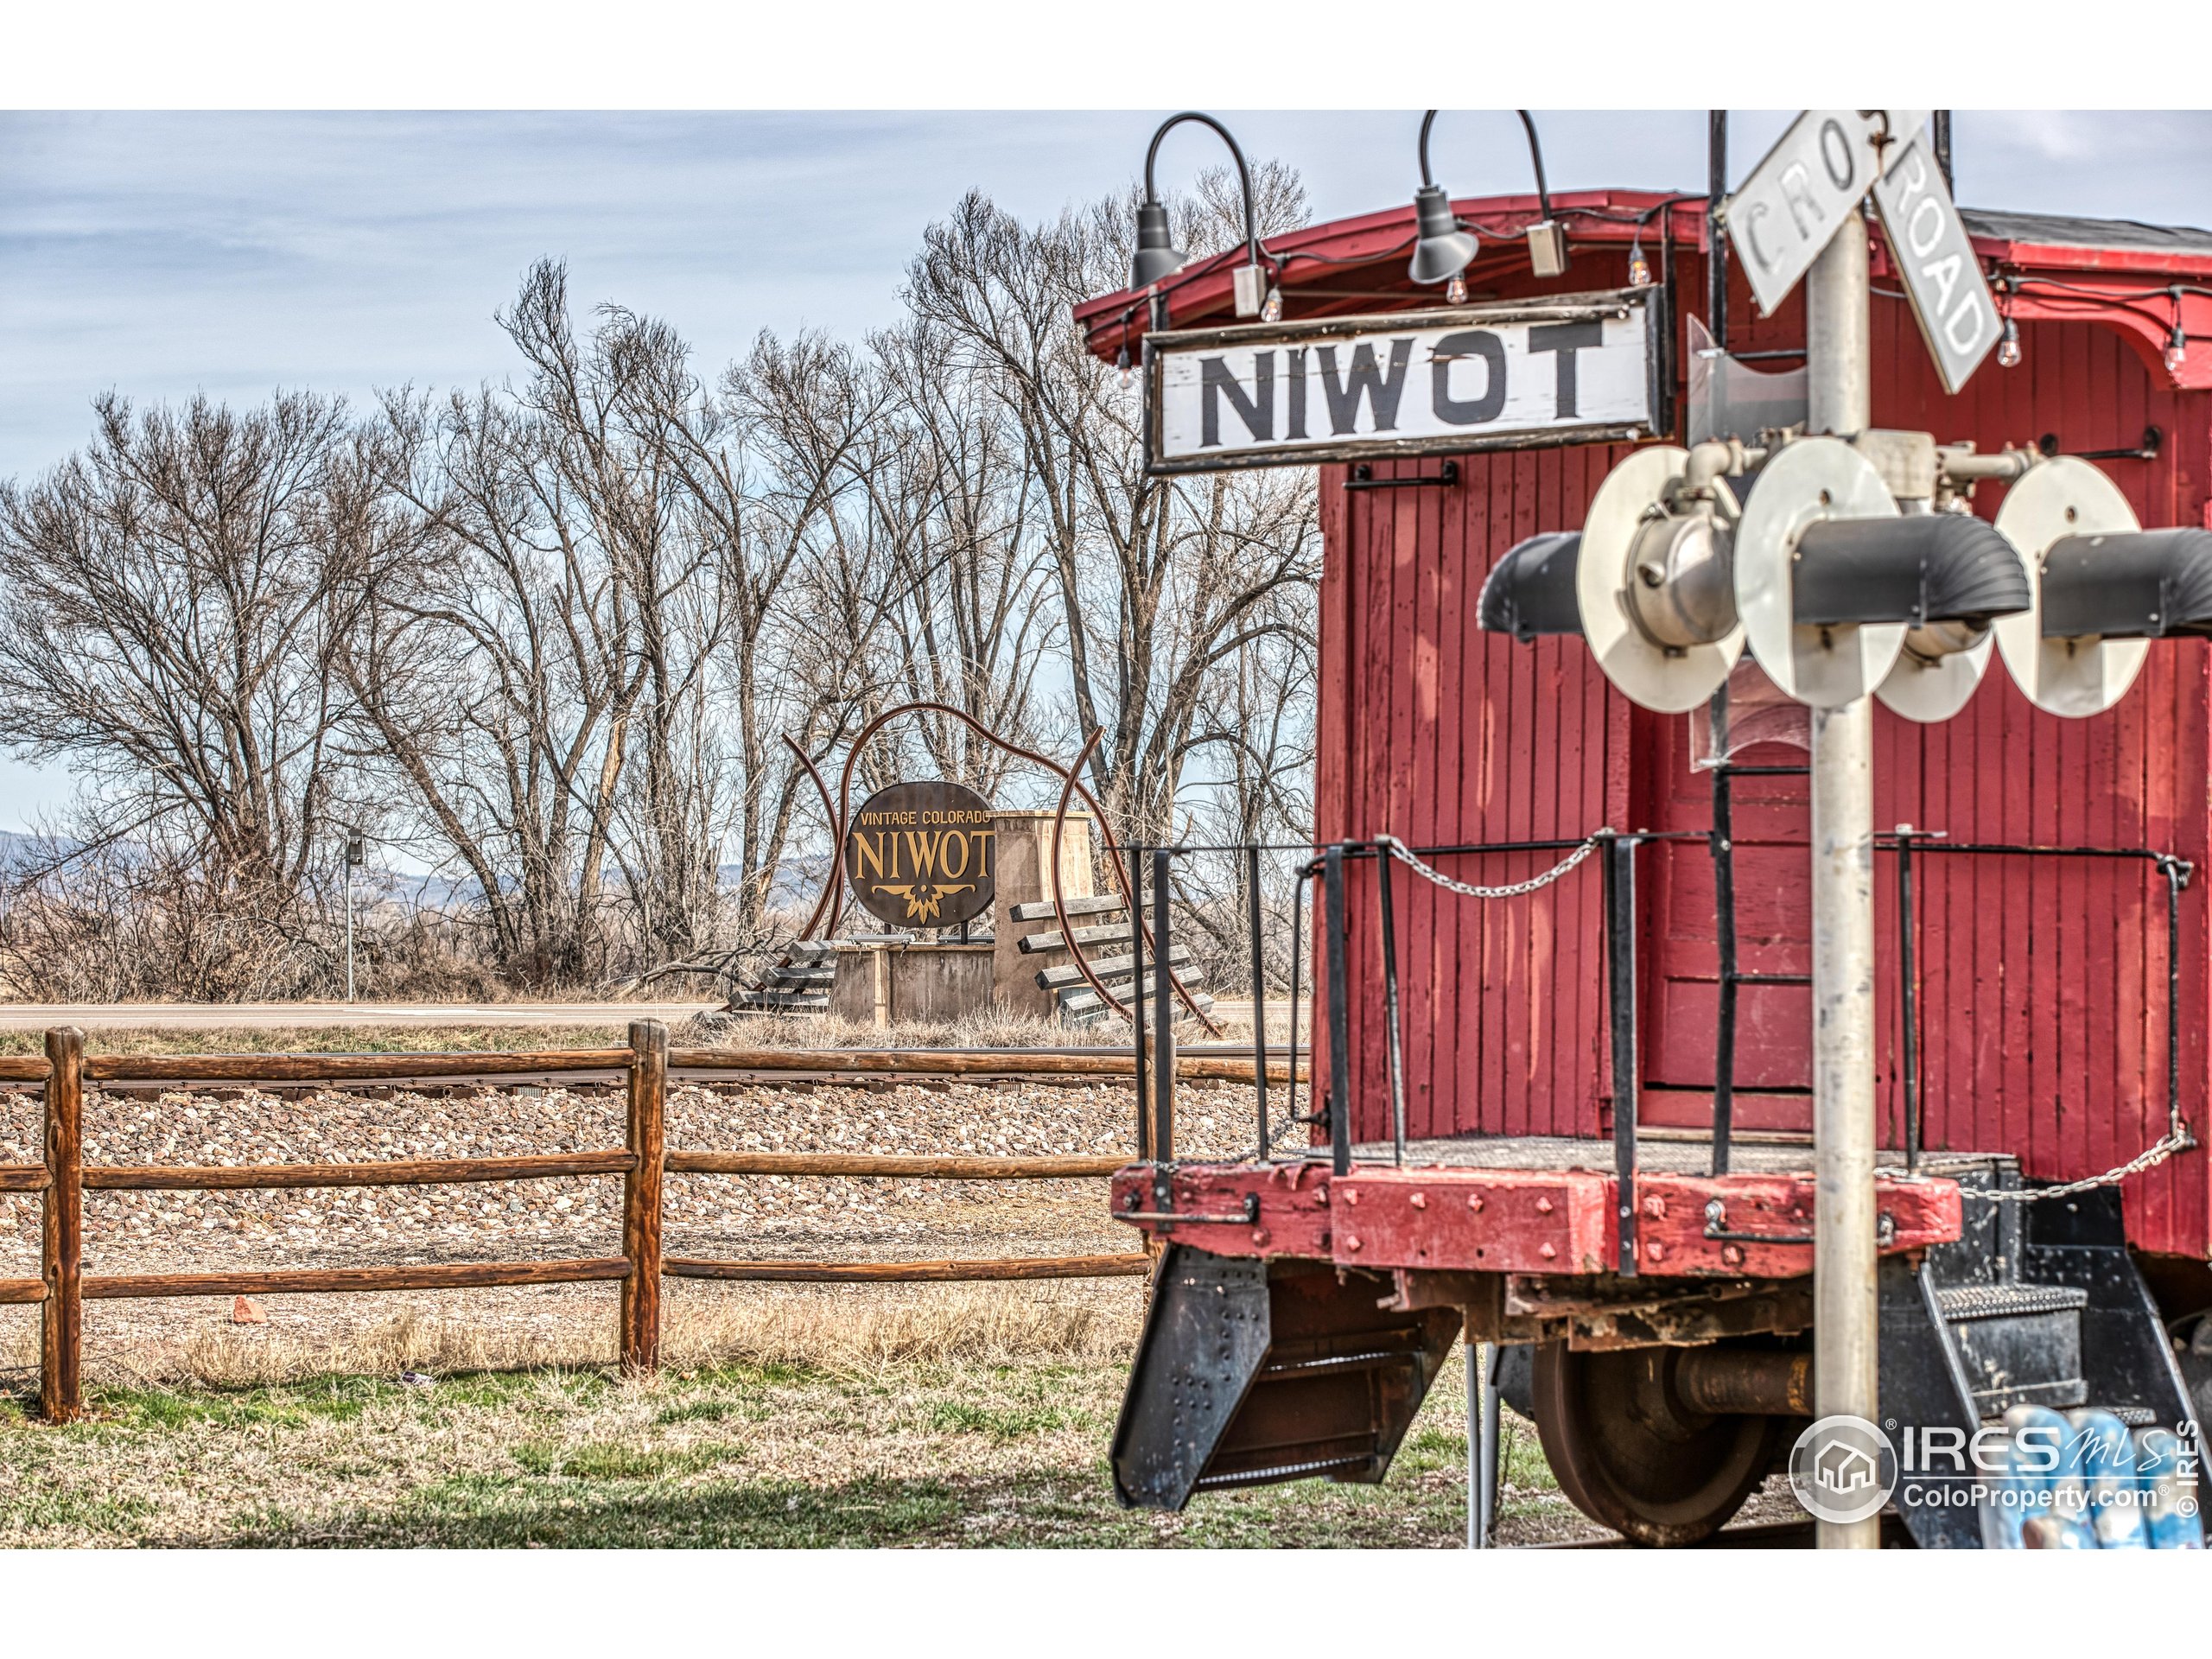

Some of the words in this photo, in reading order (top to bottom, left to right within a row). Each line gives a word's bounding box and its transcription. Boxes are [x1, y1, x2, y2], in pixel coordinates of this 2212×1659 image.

[1884, 140, 1985, 356] ROAD
[1198, 322, 1604, 448] NIWOT
[852, 830, 995, 880] NIWOT
[861, 811, 917, 826] VINTAGE
[922, 810, 992, 825] COLORADO
